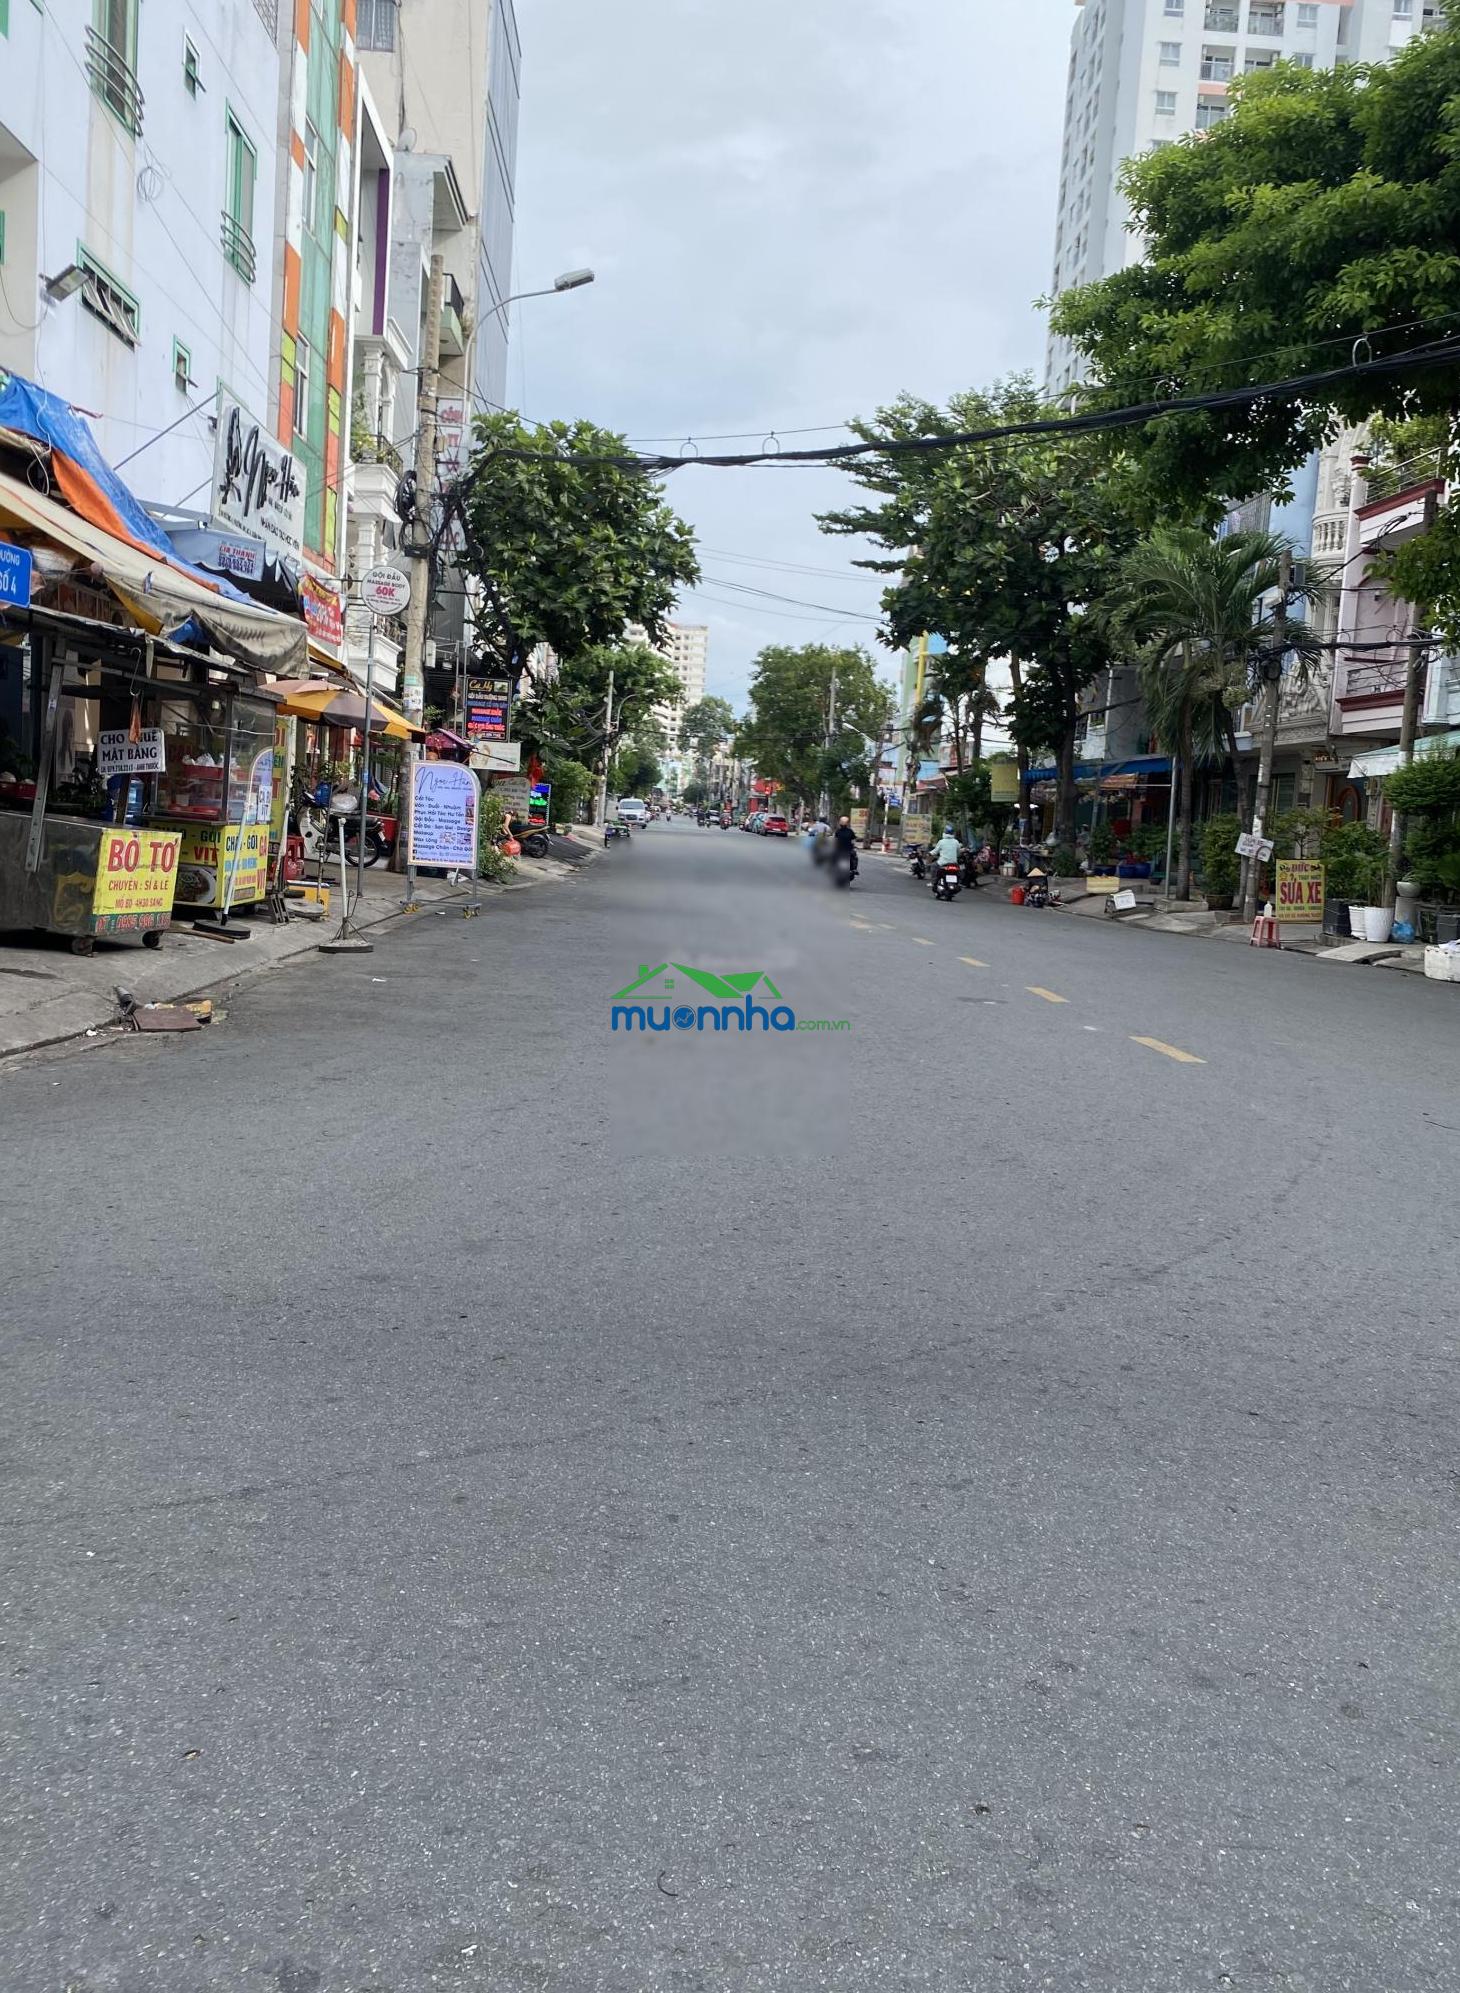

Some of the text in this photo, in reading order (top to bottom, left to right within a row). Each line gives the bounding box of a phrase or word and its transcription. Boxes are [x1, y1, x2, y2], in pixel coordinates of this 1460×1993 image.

[10, 575, 17, 595] 4
[375, 586, 395, 598] 60K
[100, 733, 125, 745] CHO
[102, 748, 125, 763] MẶT
[107, 832, 140, 873] BÒ
[149, 838, 179, 873] TƠ
[1307, 881, 1322, 904] XE
